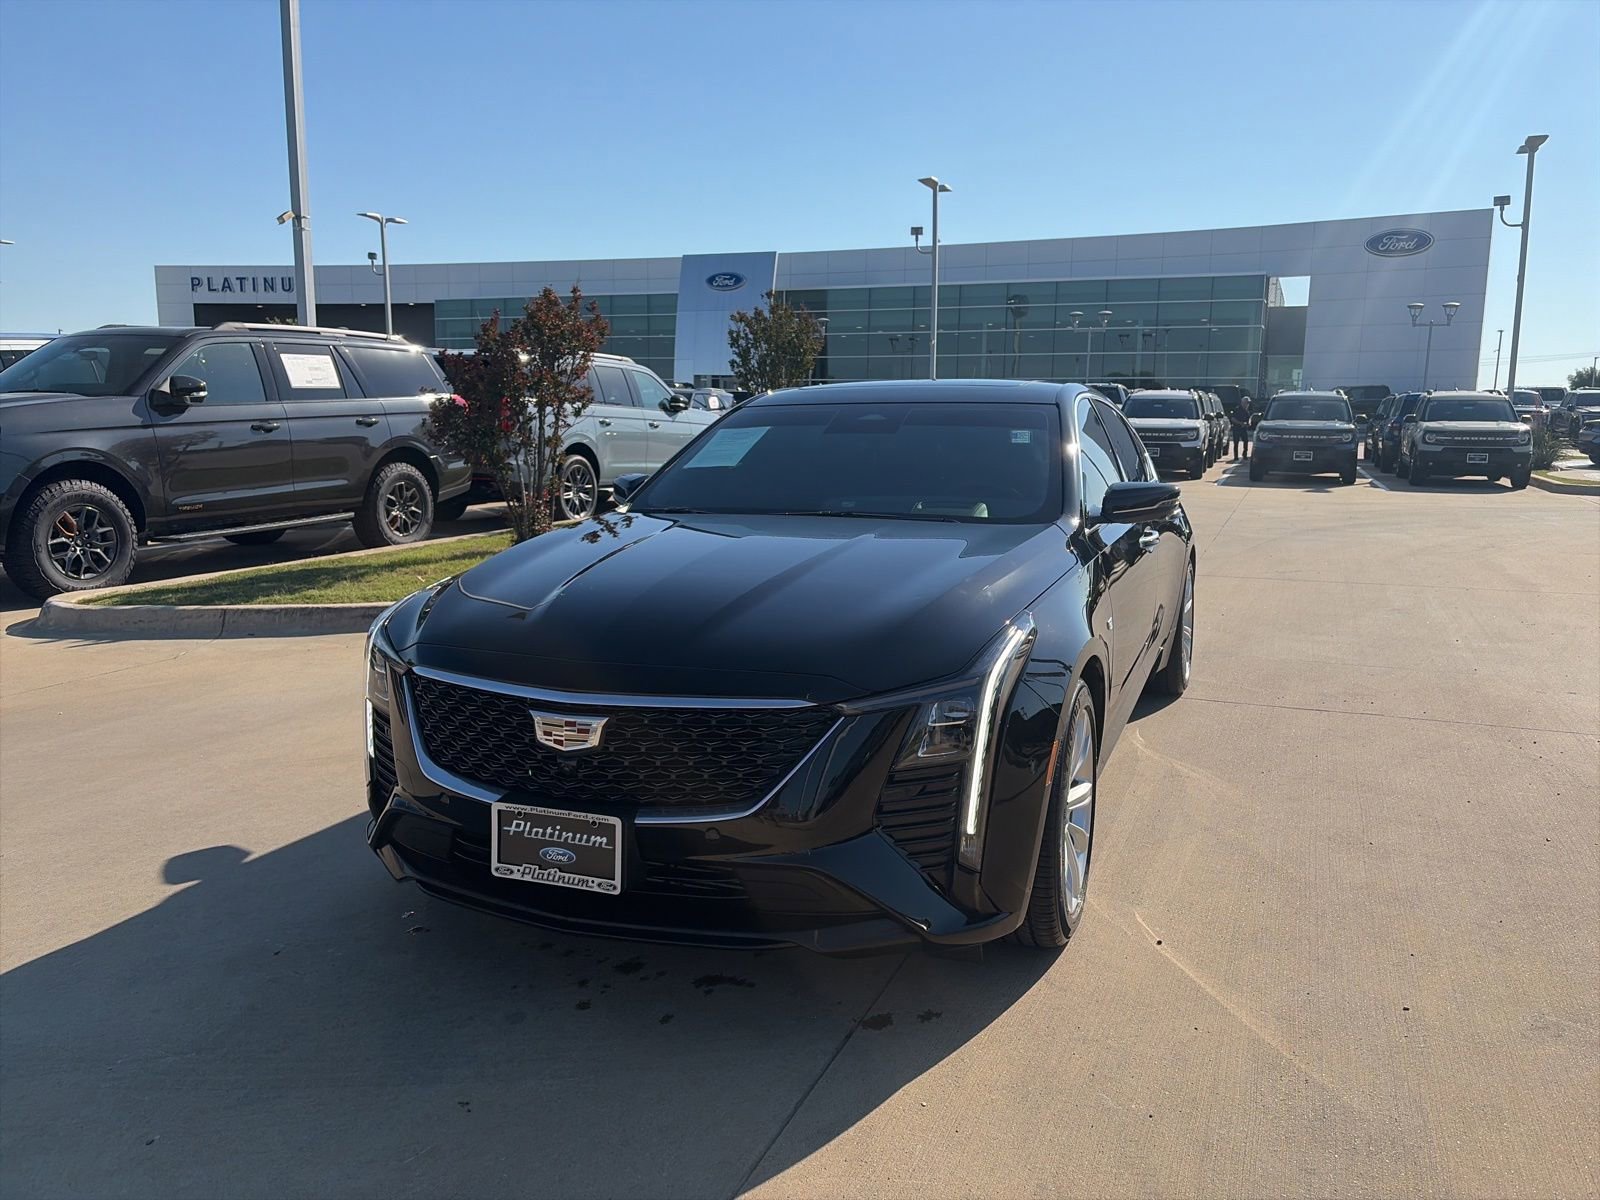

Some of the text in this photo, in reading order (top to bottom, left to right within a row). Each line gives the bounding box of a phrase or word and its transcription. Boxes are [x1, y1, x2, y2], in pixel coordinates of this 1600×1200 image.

[1378, 235, 1418, 250] Ford
[191, 277, 294, 293] PLATINU
[712, 275, 736, 286] Ford
[504, 805, 610, 822] www.PlatinumFord.com
[503, 820, 613, 849] Platinum
[546, 849, 569, 863] Ford
[521, 866, 595, 889] Platinum
